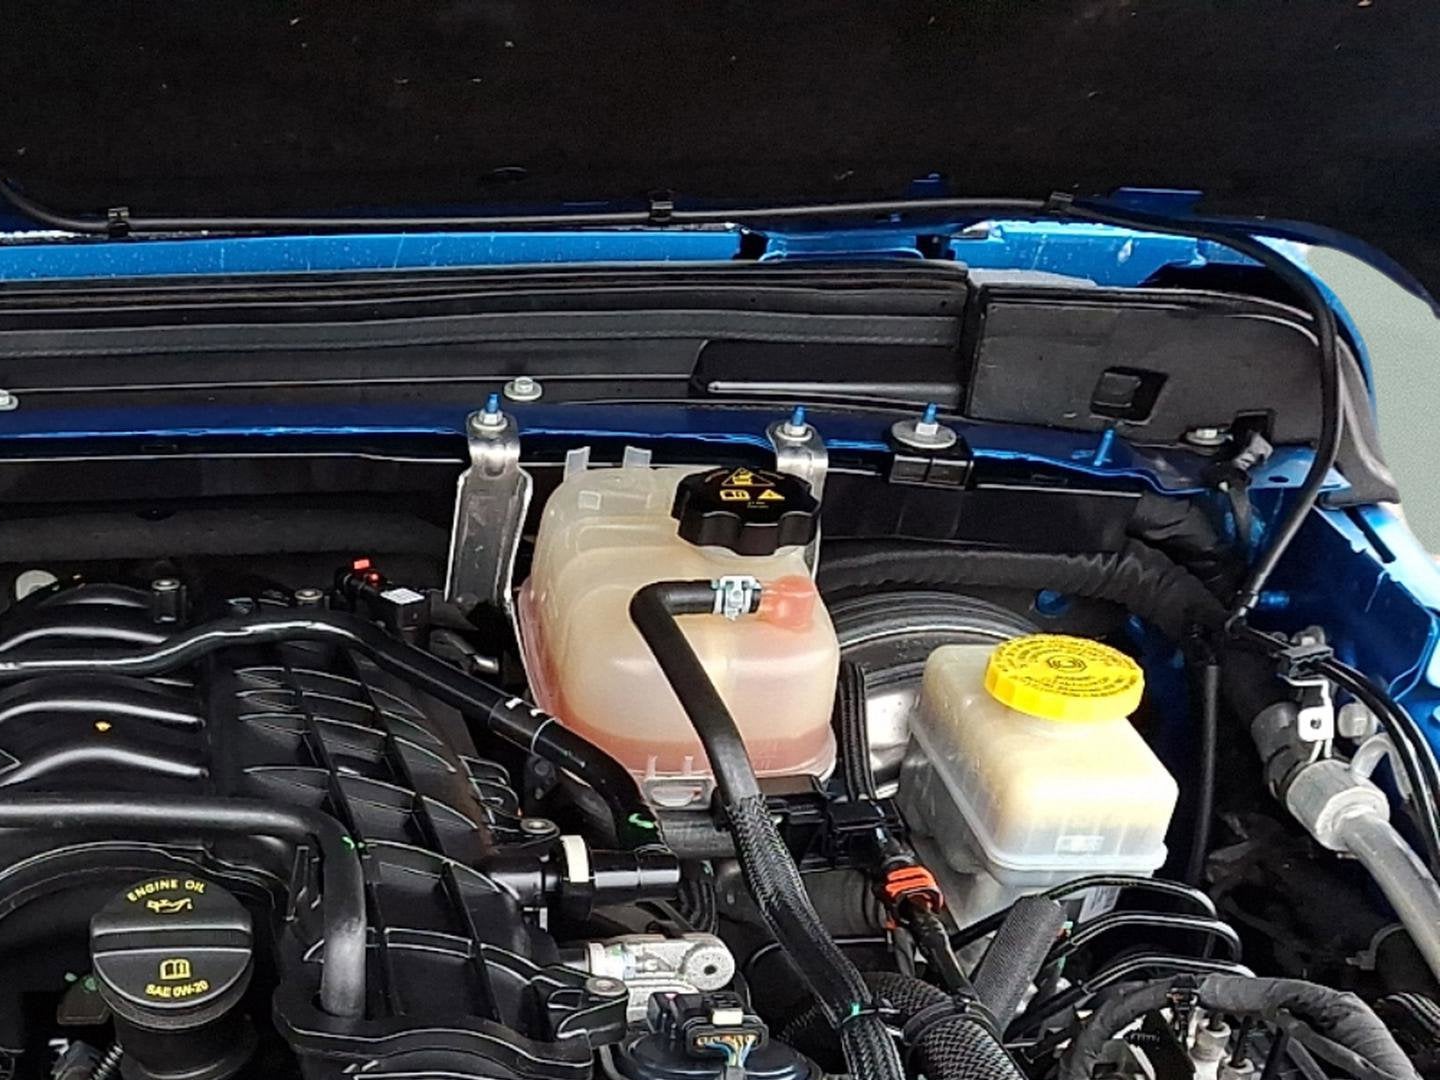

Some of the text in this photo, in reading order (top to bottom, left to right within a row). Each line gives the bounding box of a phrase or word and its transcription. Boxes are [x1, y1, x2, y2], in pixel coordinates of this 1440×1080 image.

[127, 879, 205, 901] ENGINE OIL
[145, 980, 209, 998] SAE 0W-20
